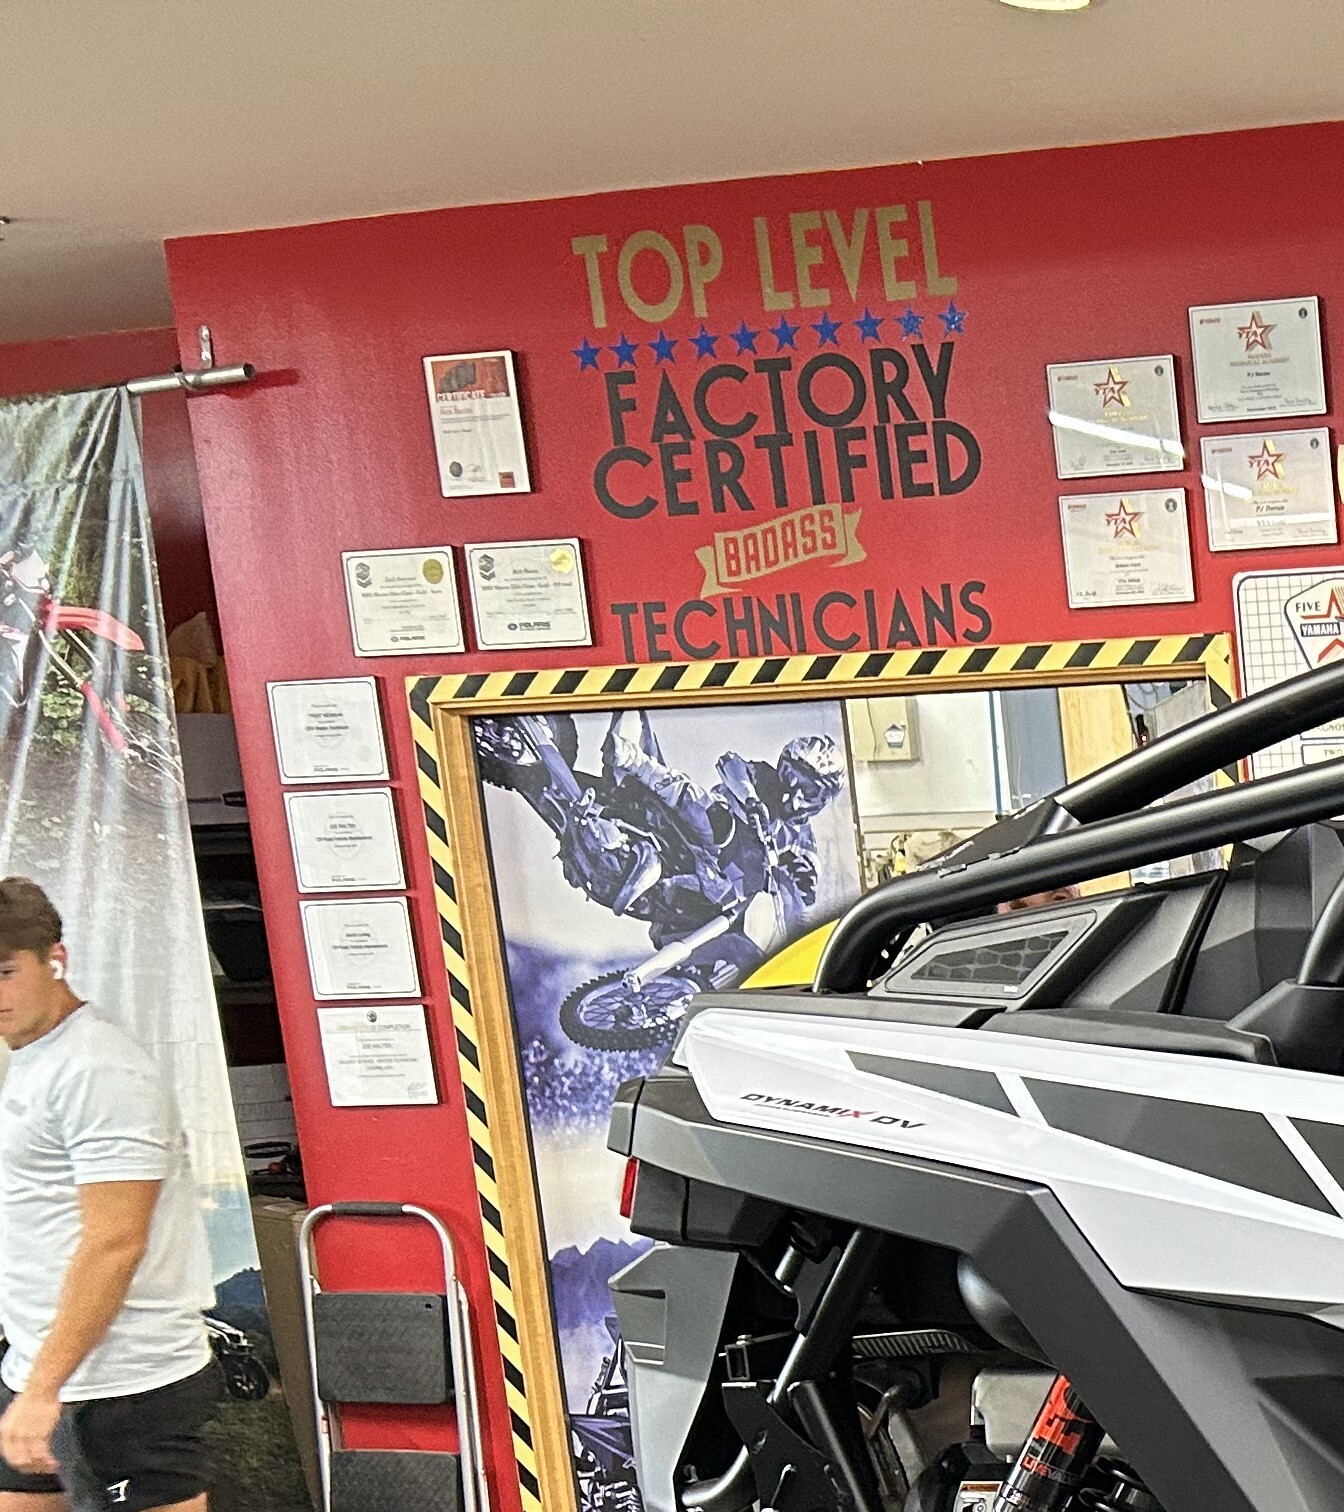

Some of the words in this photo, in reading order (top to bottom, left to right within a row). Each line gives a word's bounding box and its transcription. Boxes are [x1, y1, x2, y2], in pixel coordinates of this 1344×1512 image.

[571, 225, 723, 328] TOP
[754, 200, 957, 311] LEVEL
[605, 341, 954, 445] FACTORY
[593, 420, 982, 519] CERTIFIED
[725, 512, 840, 576] BADASS
[611, 581, 992, 663] TECHNICIANS
[1296, 601, 1321, 613] FIVE
[1301, 623, 1340, 636] YAMAHA
[740, 1093, 878, 1118] DYNAMIX
[869, 1116, 928, 1129] DV
